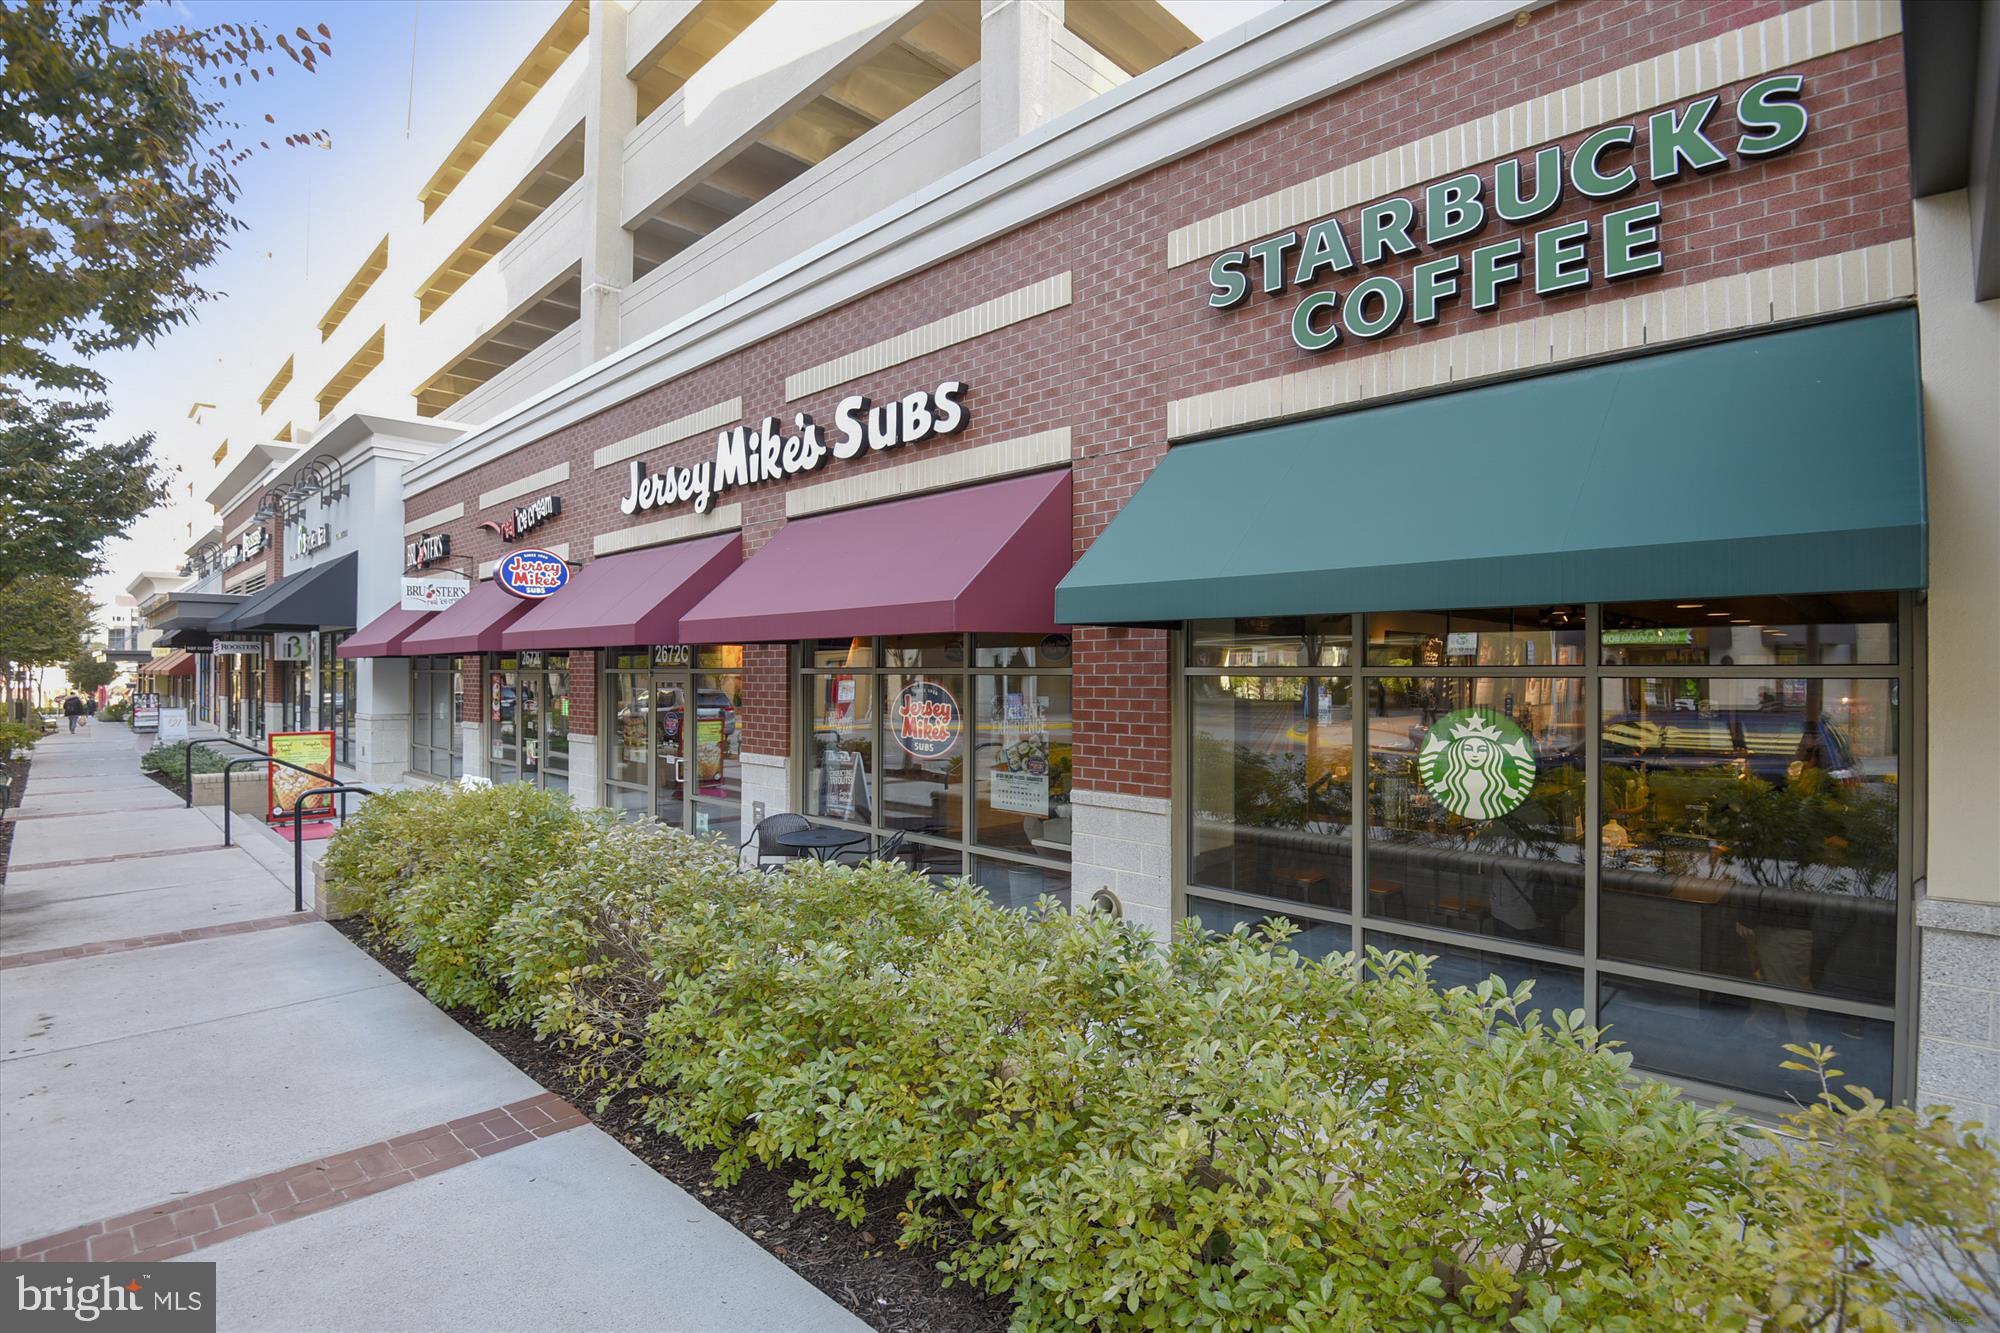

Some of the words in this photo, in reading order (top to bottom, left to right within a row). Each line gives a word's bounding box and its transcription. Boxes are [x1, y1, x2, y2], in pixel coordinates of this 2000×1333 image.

[1208, 74, 1809, 308] STARBUCKS
[1291, 201, 1664, 352] COFFEE
[620, 460, 714, 515] Jersey
[714, 412, 827, 492] Mike's
[833, 381, 966, 460] SUBS
[515, 508, 528, 533] ice
[527, 495, 553, 527] cream
[508, 556, 562, 577] Jersey
[511, 570, 561, 587] Mike's
[221, 643, 261, 651] ROOSTERS
[655, 644, 689, 663] 2672C
[899, 694, 952, 724] Jersey
[901, 715, 951, 742] Mike's
[914, 742, 935, 752] SUBS
